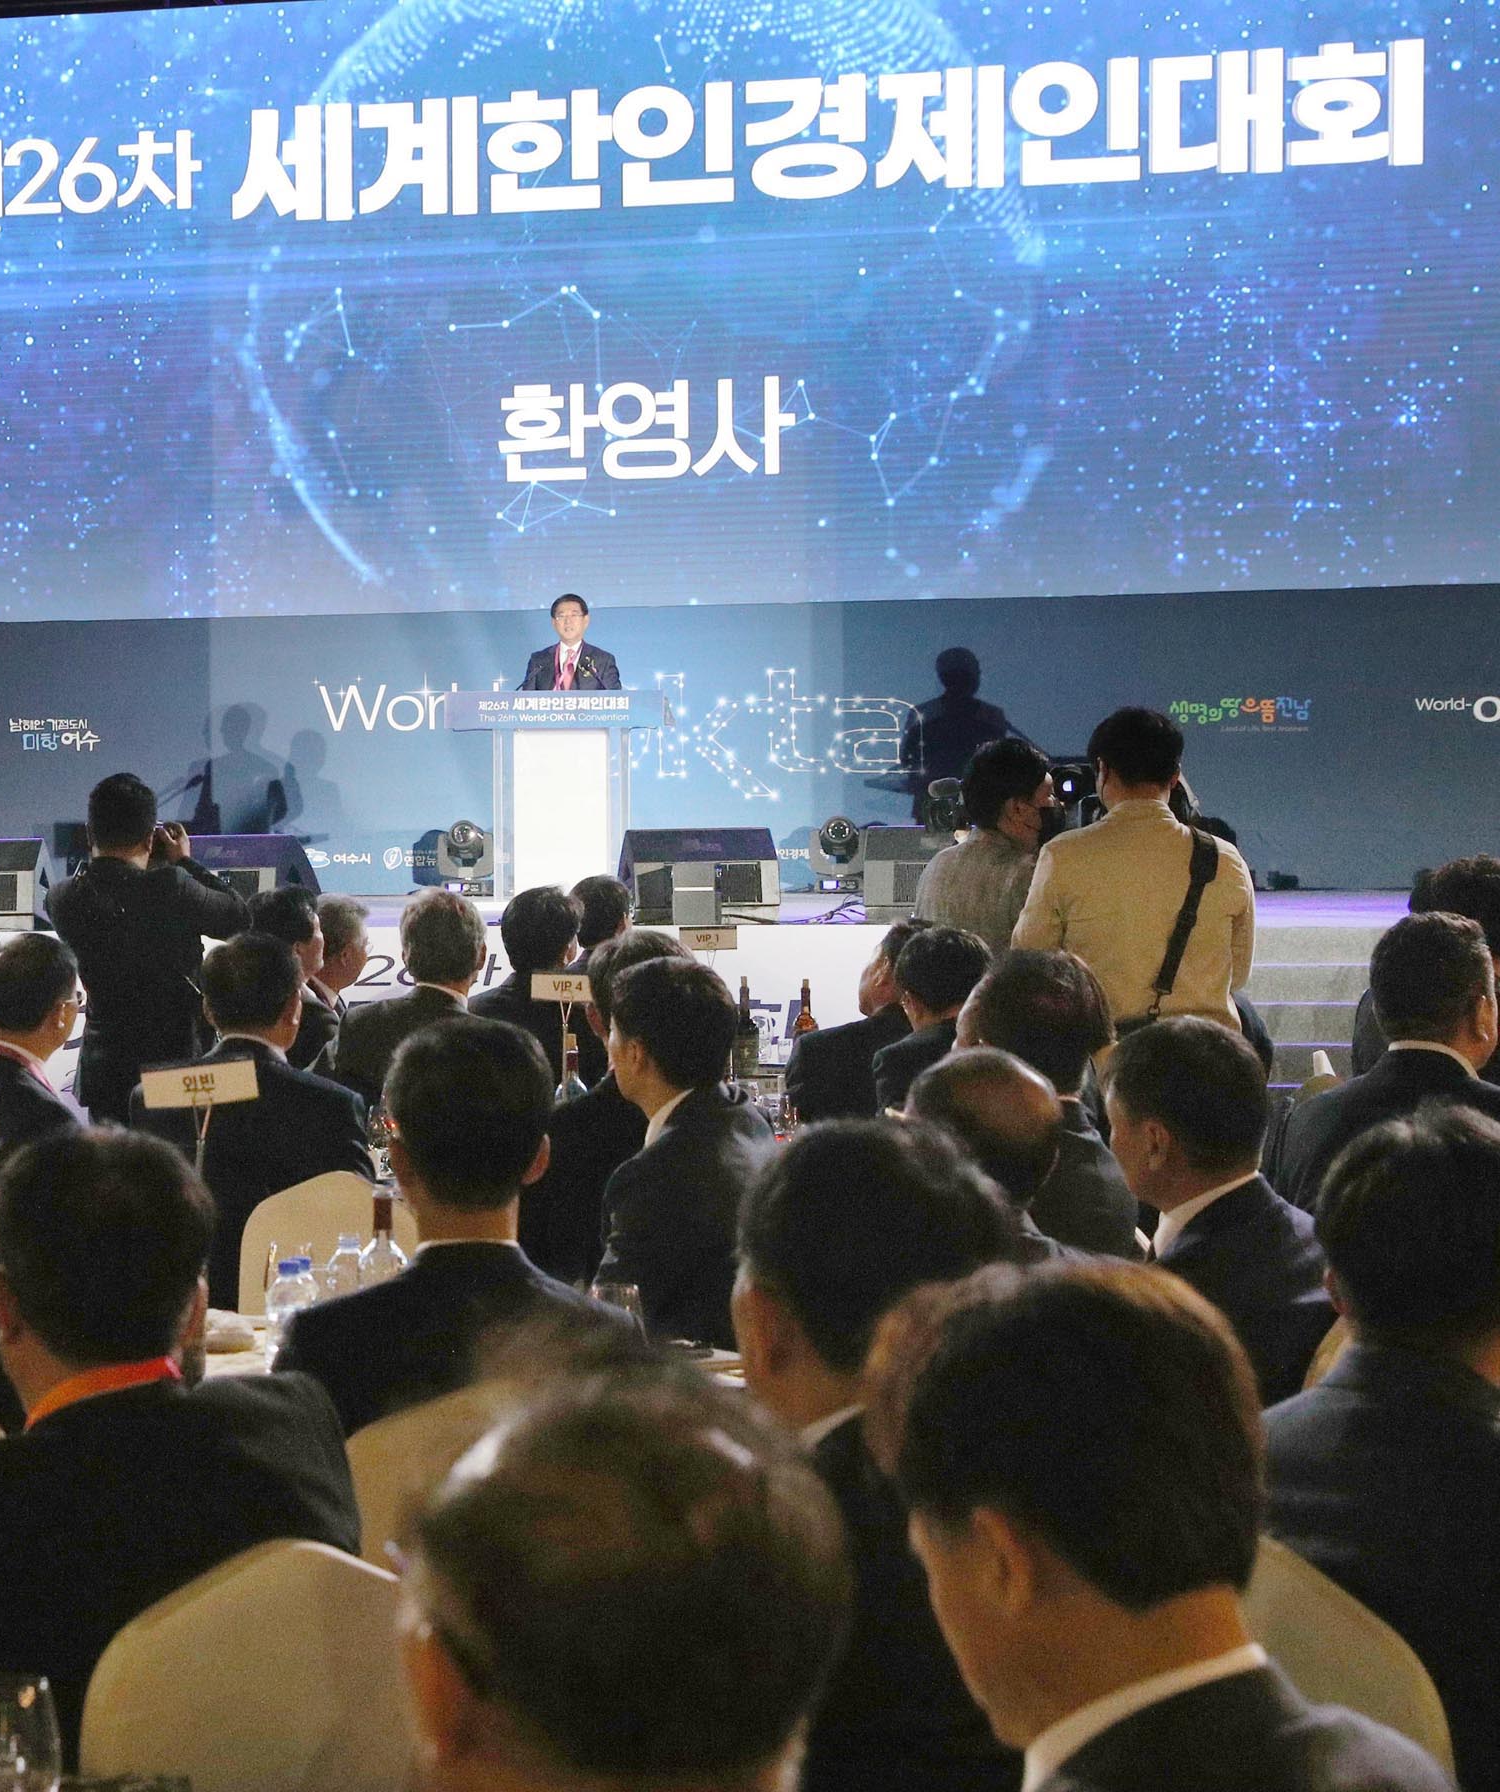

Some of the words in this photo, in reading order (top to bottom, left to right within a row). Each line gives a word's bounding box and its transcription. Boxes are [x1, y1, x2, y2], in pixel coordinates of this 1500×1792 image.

[232, 36, 1426, 222] 세계한인경제인대회
[499, 374, 795, 484] 환영사
[478, 700, 509, 711] 제26차
[512, 695, 629, 711] 세계한인경제인대회
[478, 713, 496, 722] The
[498, 713, 518, 722] 26th
[519, 713, 576, 722] World-OKTA
[578, 712, 629, 721] Convention
[22, 733, 60, 751] 미항
[61, 730, 101, 751] 여수
[333, 852, 372, 865] 여수시
[404, 855, 437, 867] 연합뉴
[695, 934, 711, 943] VIP
[553, 980, 572, 992] VIP
[575, 981, 583, 992] 4
[183, 1072, 216, 1093] 외빈
